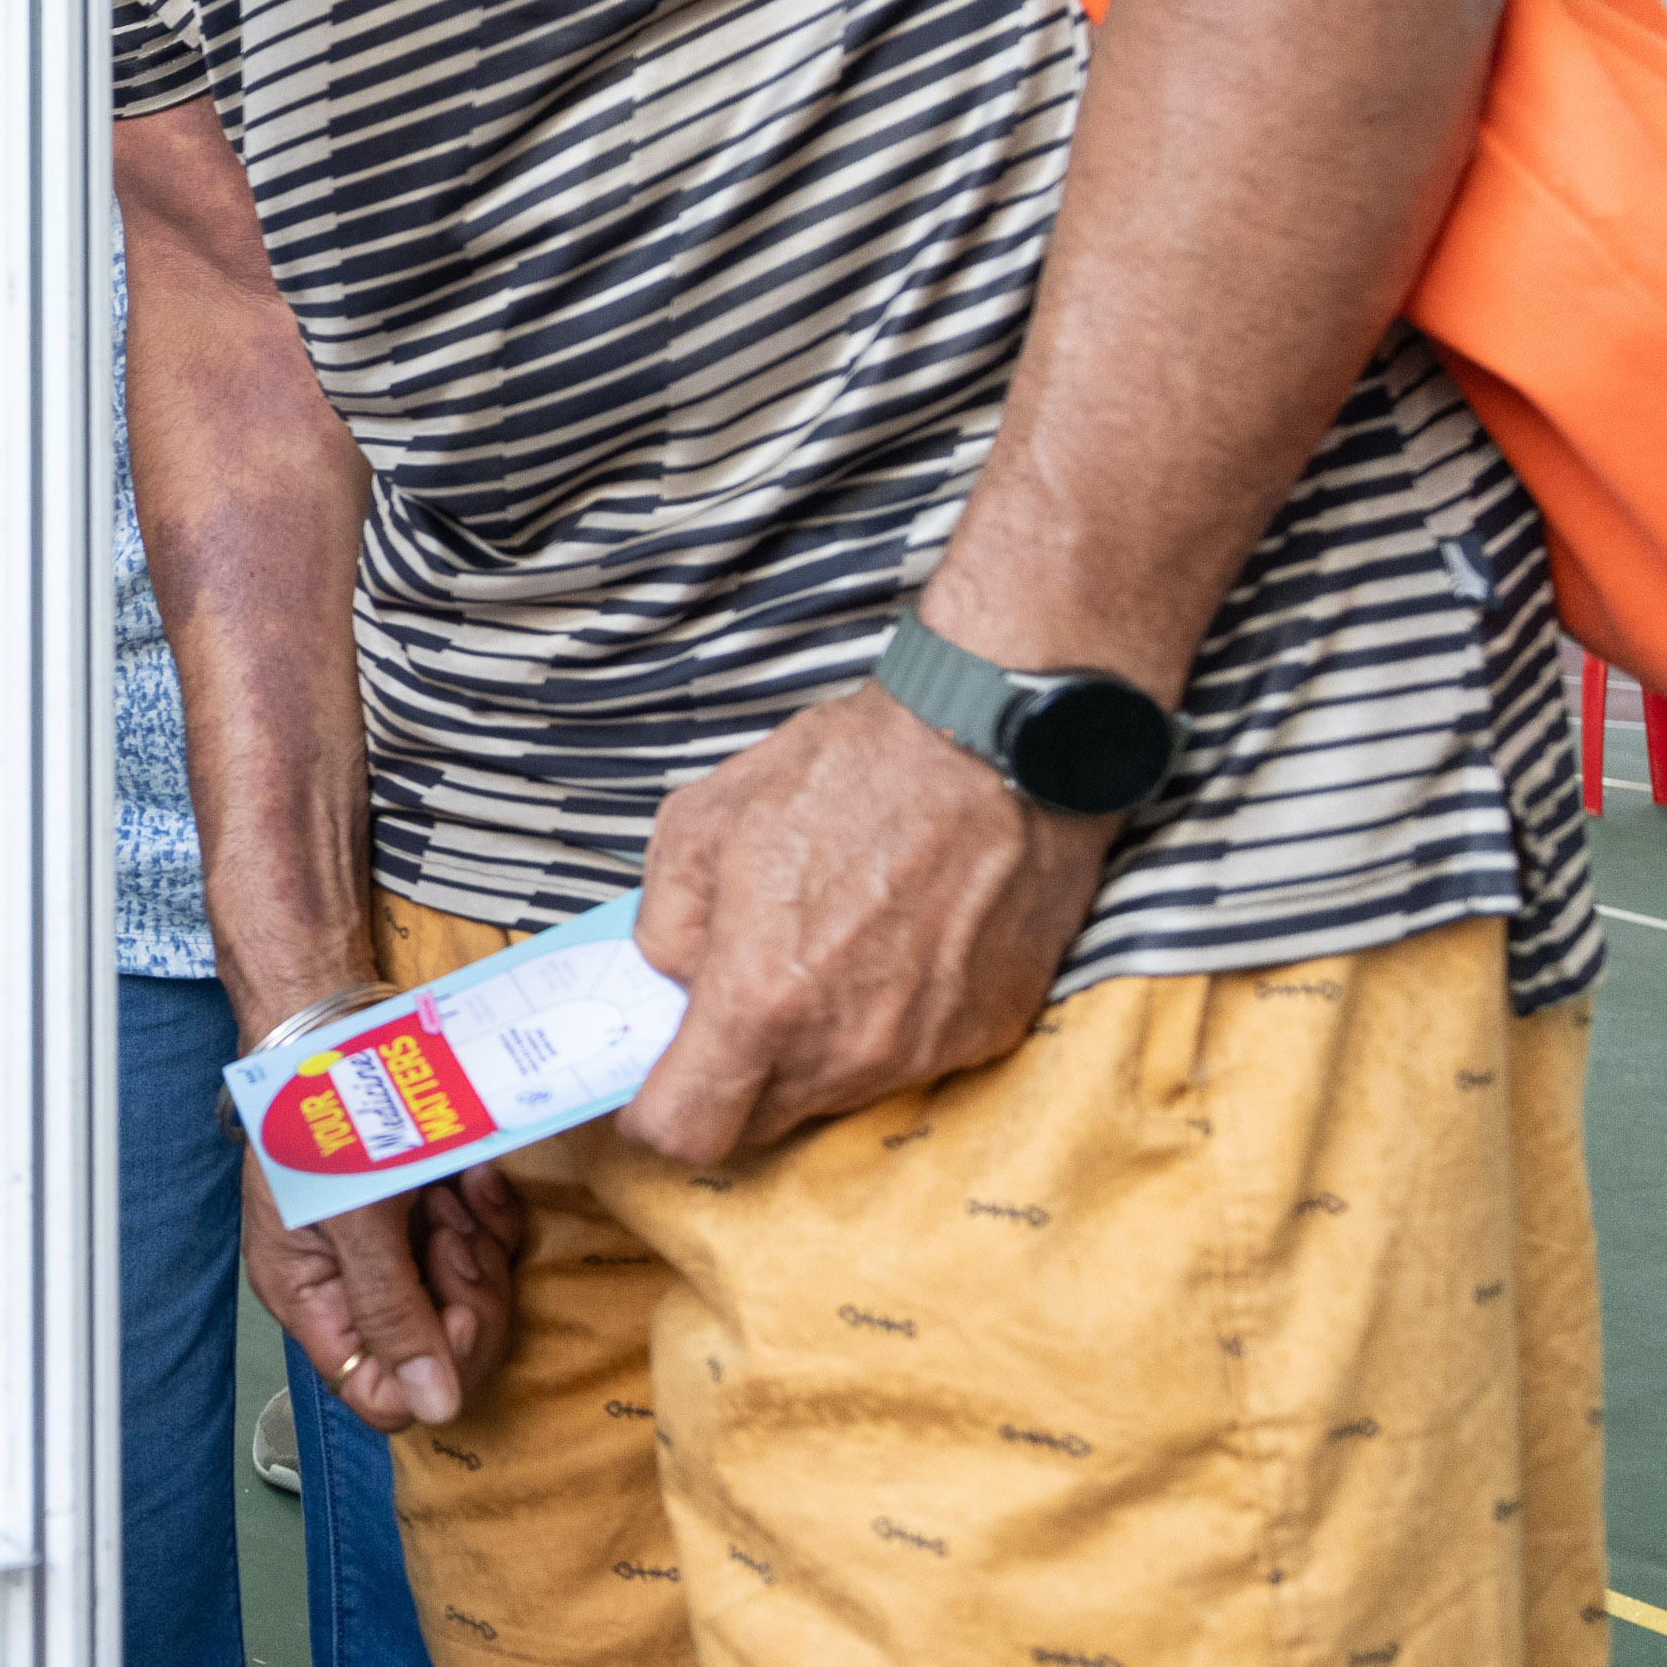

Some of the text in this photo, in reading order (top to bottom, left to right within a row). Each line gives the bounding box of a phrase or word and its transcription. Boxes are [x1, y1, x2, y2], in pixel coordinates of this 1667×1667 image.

[300, 1088, 358, 1157] YOUR
[350, 1051, 423, 1151] Medicine
[378, 1034, 466, 1143] MATTERS
